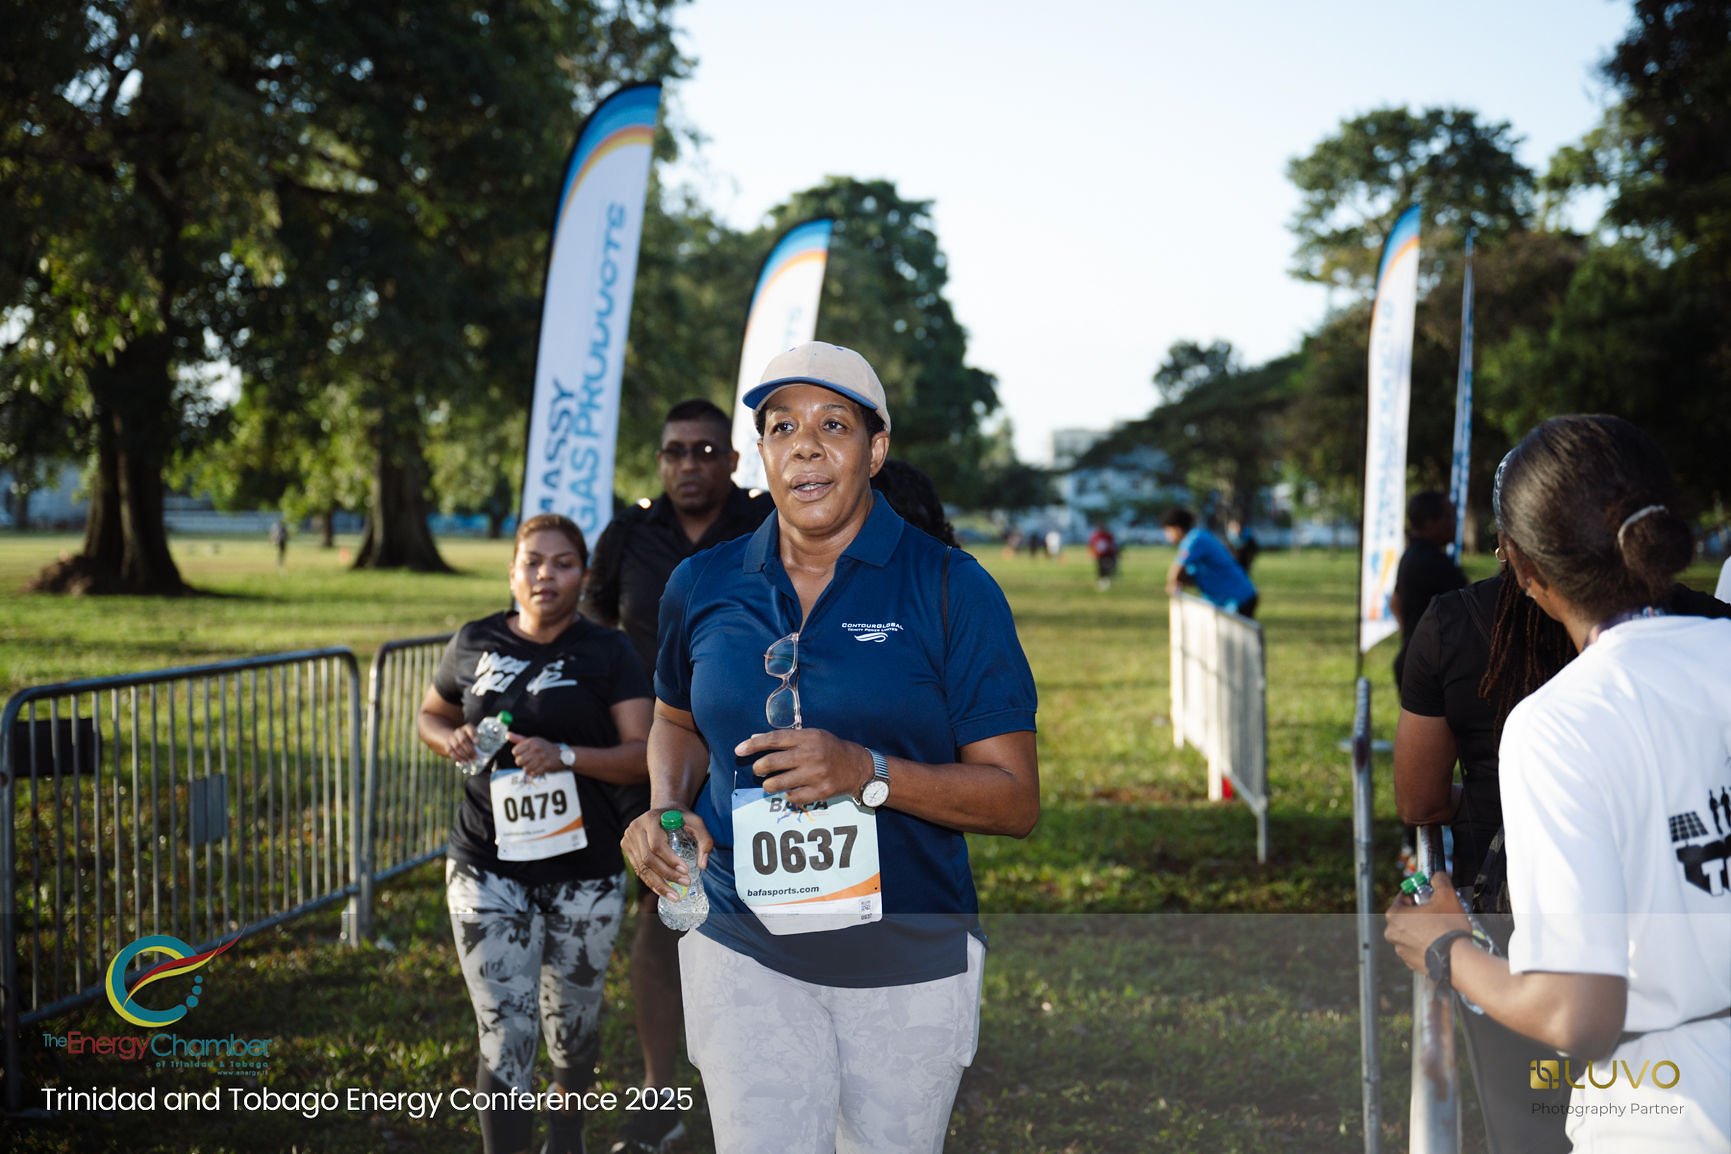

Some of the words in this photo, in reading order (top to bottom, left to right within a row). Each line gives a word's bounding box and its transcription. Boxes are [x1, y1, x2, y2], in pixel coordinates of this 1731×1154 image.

[566, 447, 602, 536] GAS
[503, 788, 568, 823] 0479
[752, 824, 858, 876] 0637
[747, 885, 820, 897] bafasports.com
